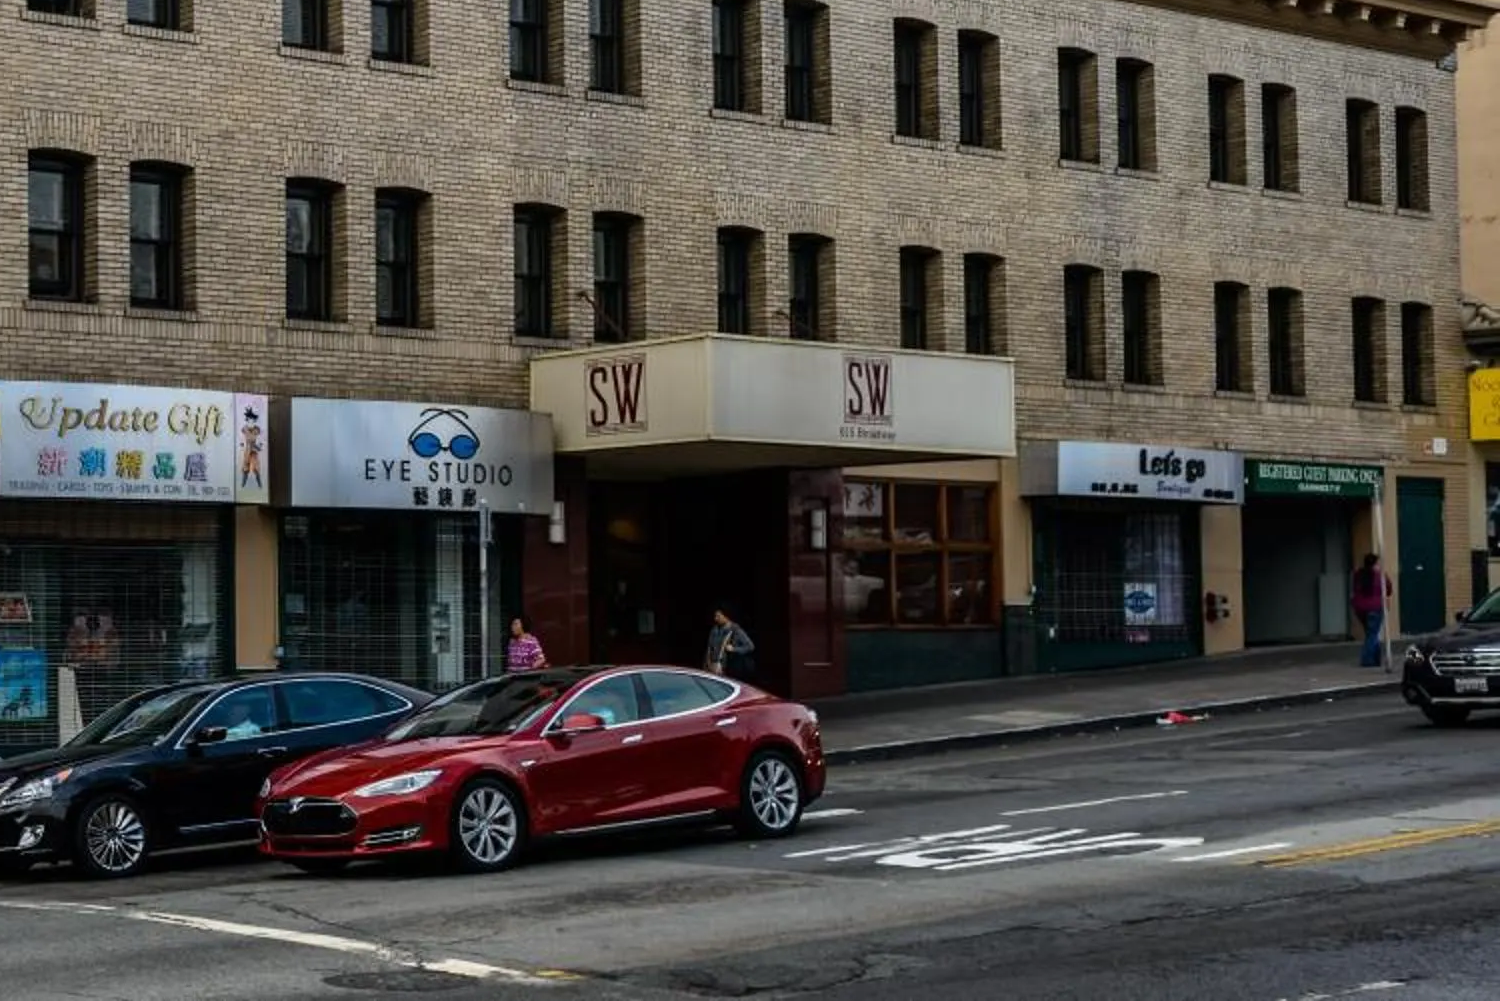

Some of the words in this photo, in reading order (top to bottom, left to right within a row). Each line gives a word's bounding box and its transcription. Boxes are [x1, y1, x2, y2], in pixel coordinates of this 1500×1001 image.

[588, 361, 644, 427] SW
[847, 361, 890, 416] SW
[18, 395, 160, 440] Update
[166, 401, 226, 445] Gift
[364, 459, 412, 482] EYE
[428, 461, 513, 486] STUDIO
